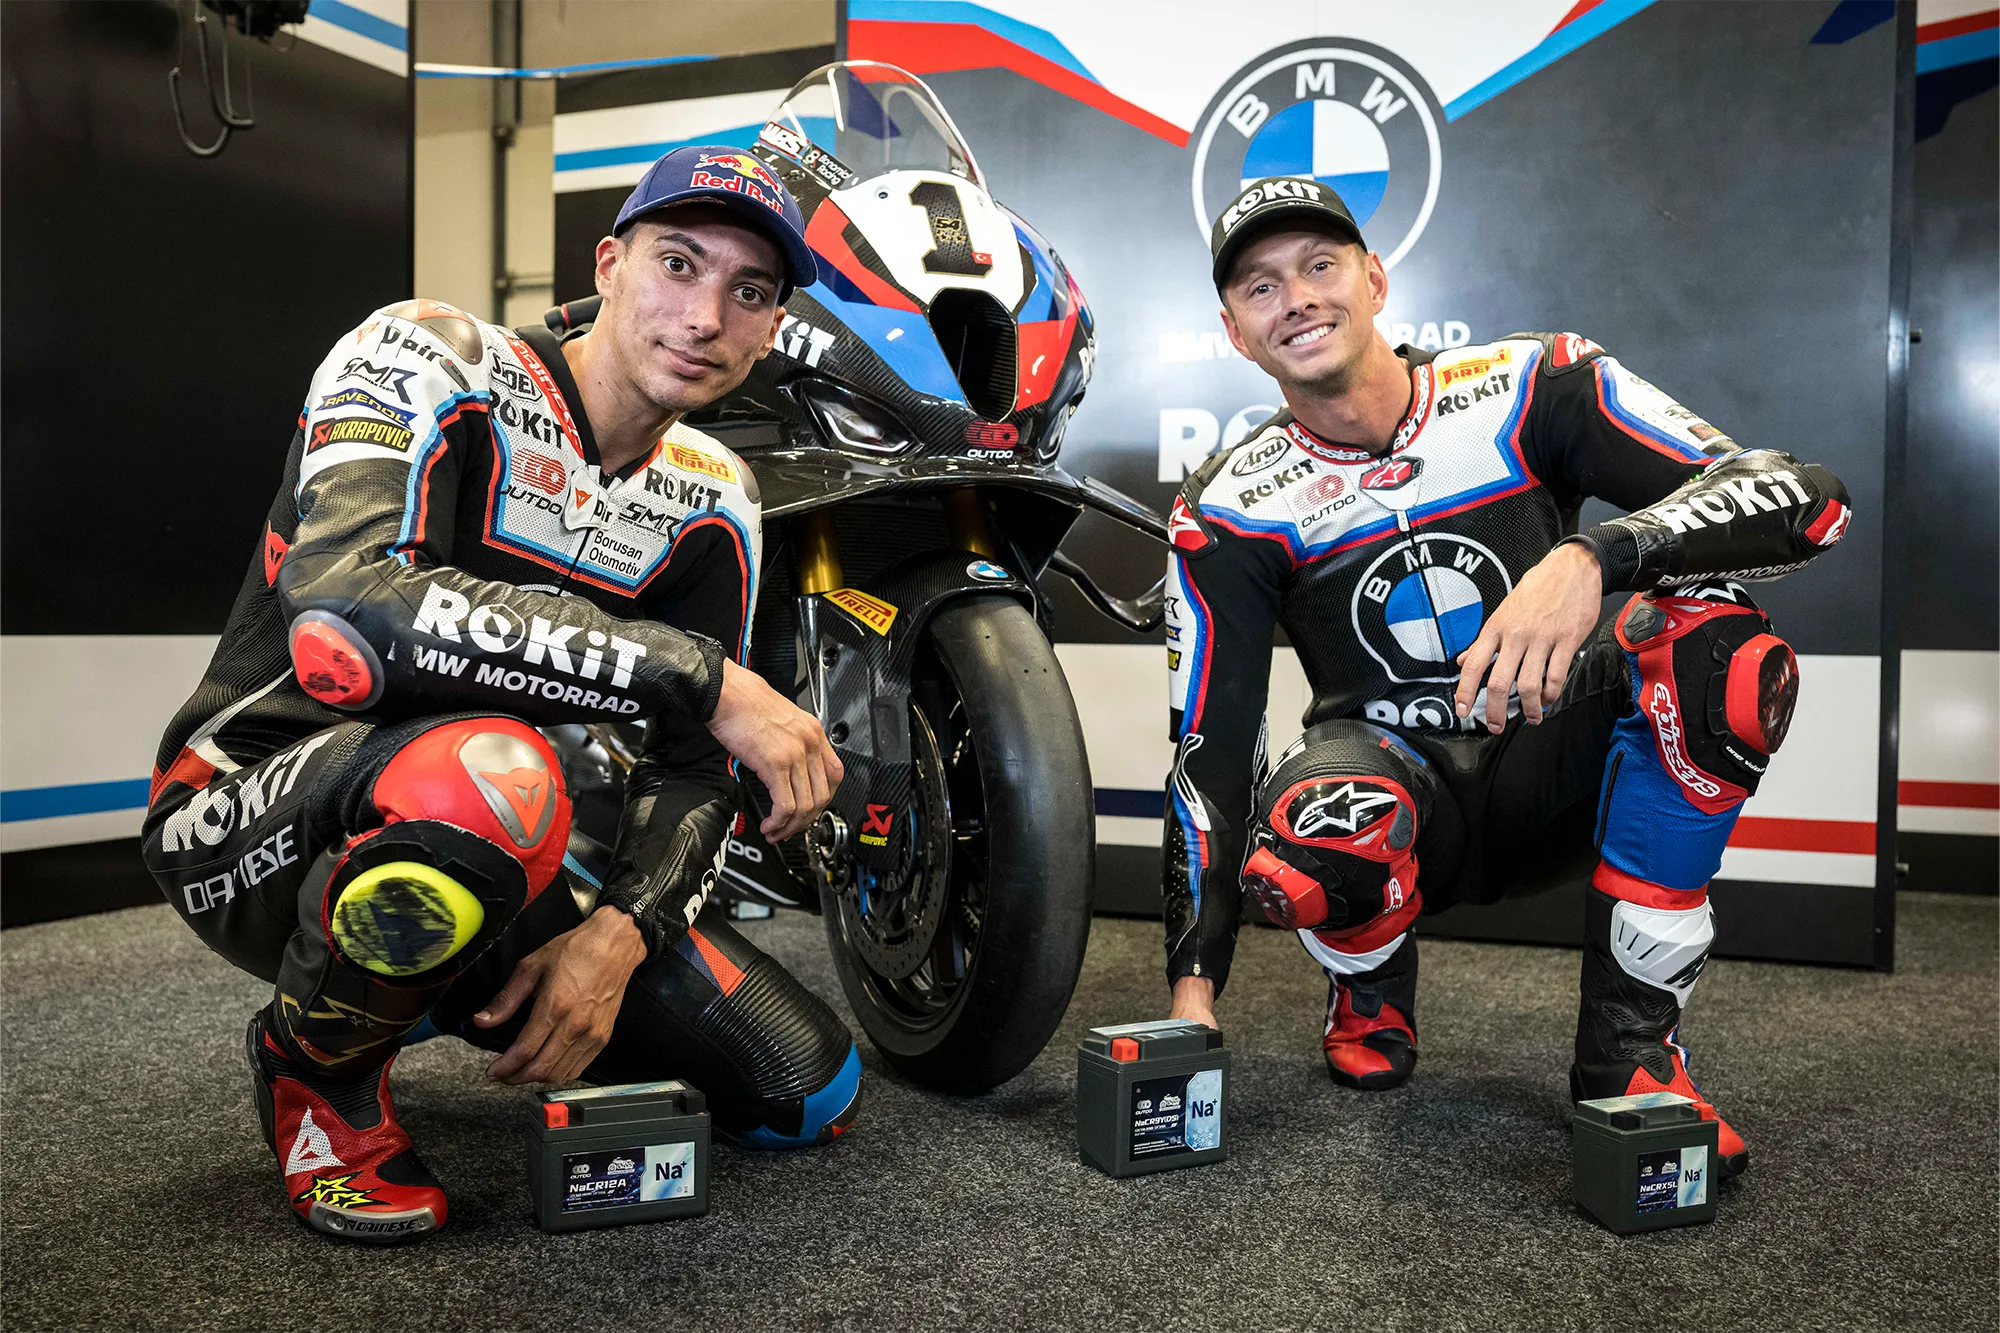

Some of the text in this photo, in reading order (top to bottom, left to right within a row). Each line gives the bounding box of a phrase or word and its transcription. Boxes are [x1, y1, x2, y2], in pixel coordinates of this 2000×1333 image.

[1226, 61, 1408, 139] BMW
[690, 171, 743, 193] Red
[909, 180, 994, 278] 1
[934, 217, 961, 232] 54
[773, 314, 836, 368] KiT
[1437, 373, 1510, 417] ROKiT
[489, 387, 566, 450] ROKiT
[671, 447, 730, 478] PIRELLI
[967, 449, 1014, 459] OUTDO
[1236, 440, 1284, 473] Arai
[644, 467, 722, 514] ROKiT
[1238, 458, 1315, 509] ROKiT
[1648, 470, 1811, 535] ROKiT
[618, 501, 684, 545] SMR
[1301, 494, 1357, 528] OUTDO
[588, 547, 642, 578] Otomotiv
[594, 530, 643, 561] Borusan
[1364, 543, 1484, 604] BMW
[1656, 571, 1714, 587] BMW
[832, 590, 892, 628] PIRELLI
[412, 581, 647, 689] ROKiT
[401, 643, 640, 714] MW MOTORRAD
[569, 1178, 627, 1193] NaCR12A
[356, 1217, 418, 1234] DAINESE
